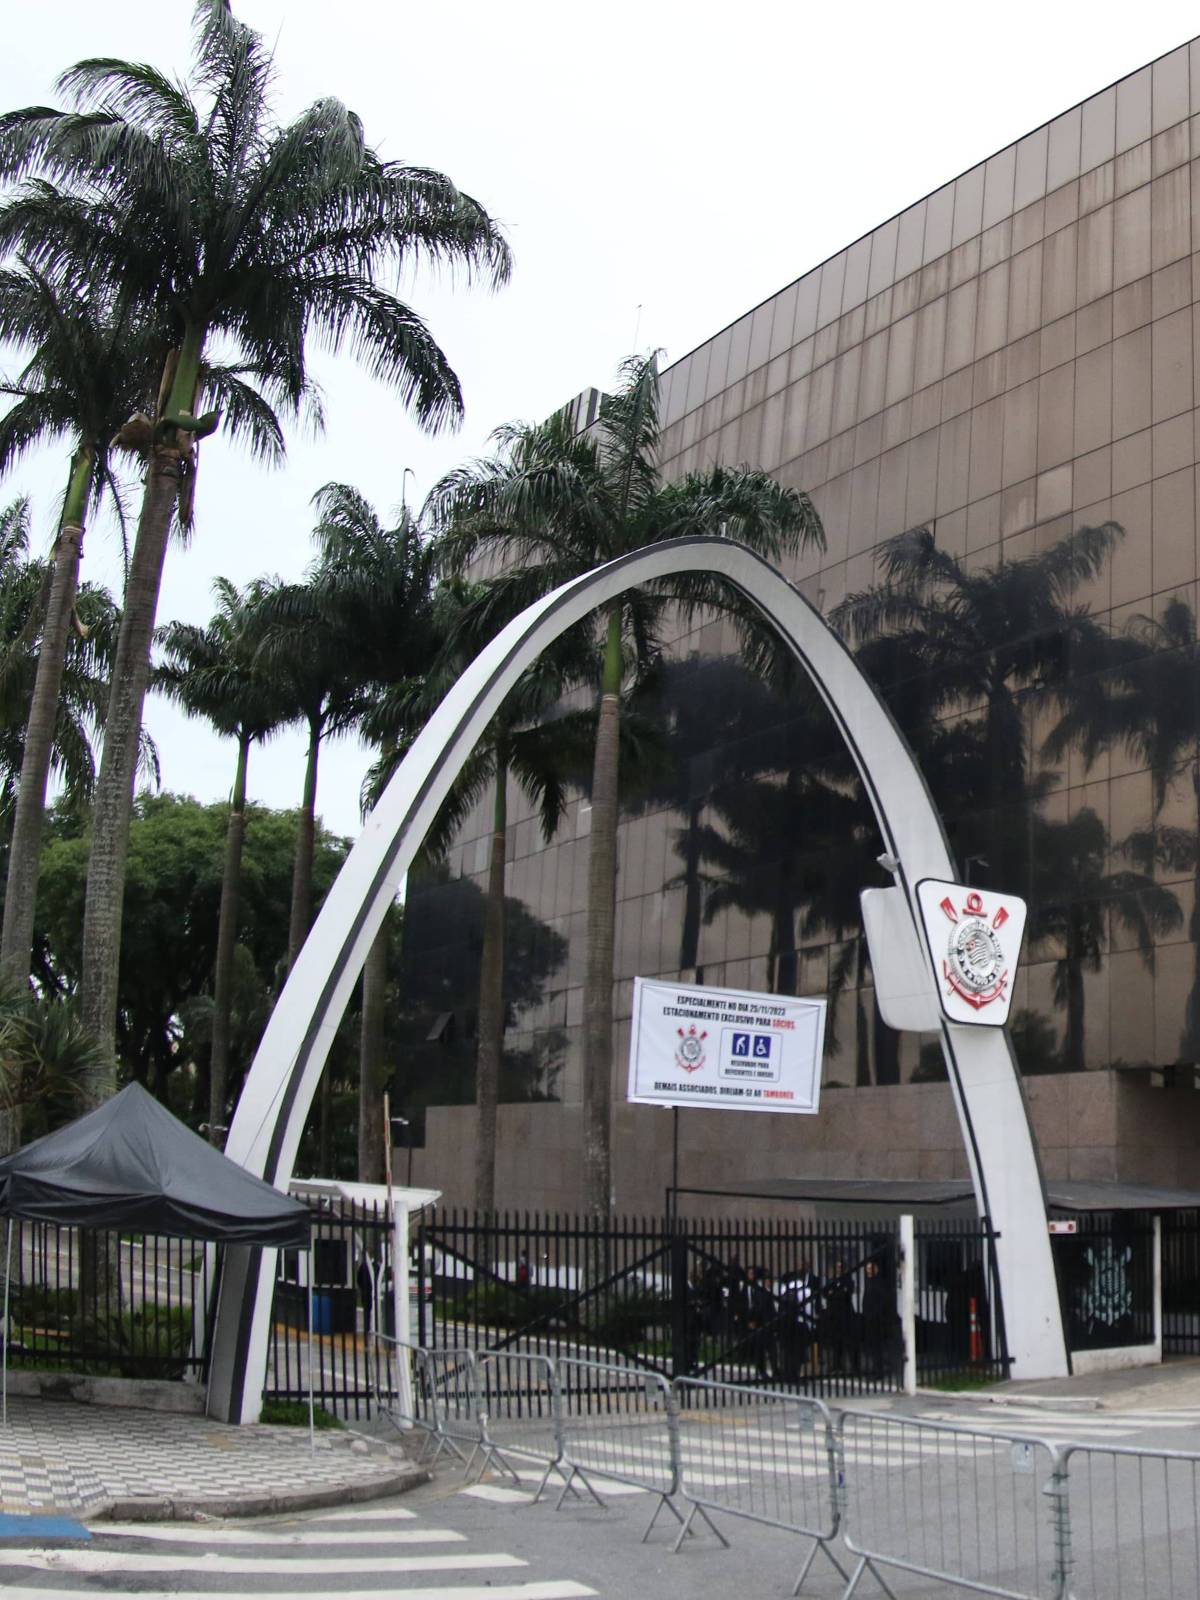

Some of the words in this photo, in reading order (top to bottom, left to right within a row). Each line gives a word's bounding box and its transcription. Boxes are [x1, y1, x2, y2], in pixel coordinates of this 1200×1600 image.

[677, 996, 727, 1009] ESPECIALMENTE
[727, 1002, 737, 1011] NO
[738, 1004, 748, 1012] DIA
[663, 1007, 720, 1020] ESTACIONAMENTO
[721, 1014, 755, 1025] EXCLUSIVO
[755, 1018, 771, 1026] PARA
[654, 1082, 677, 1091] DEMAIS
